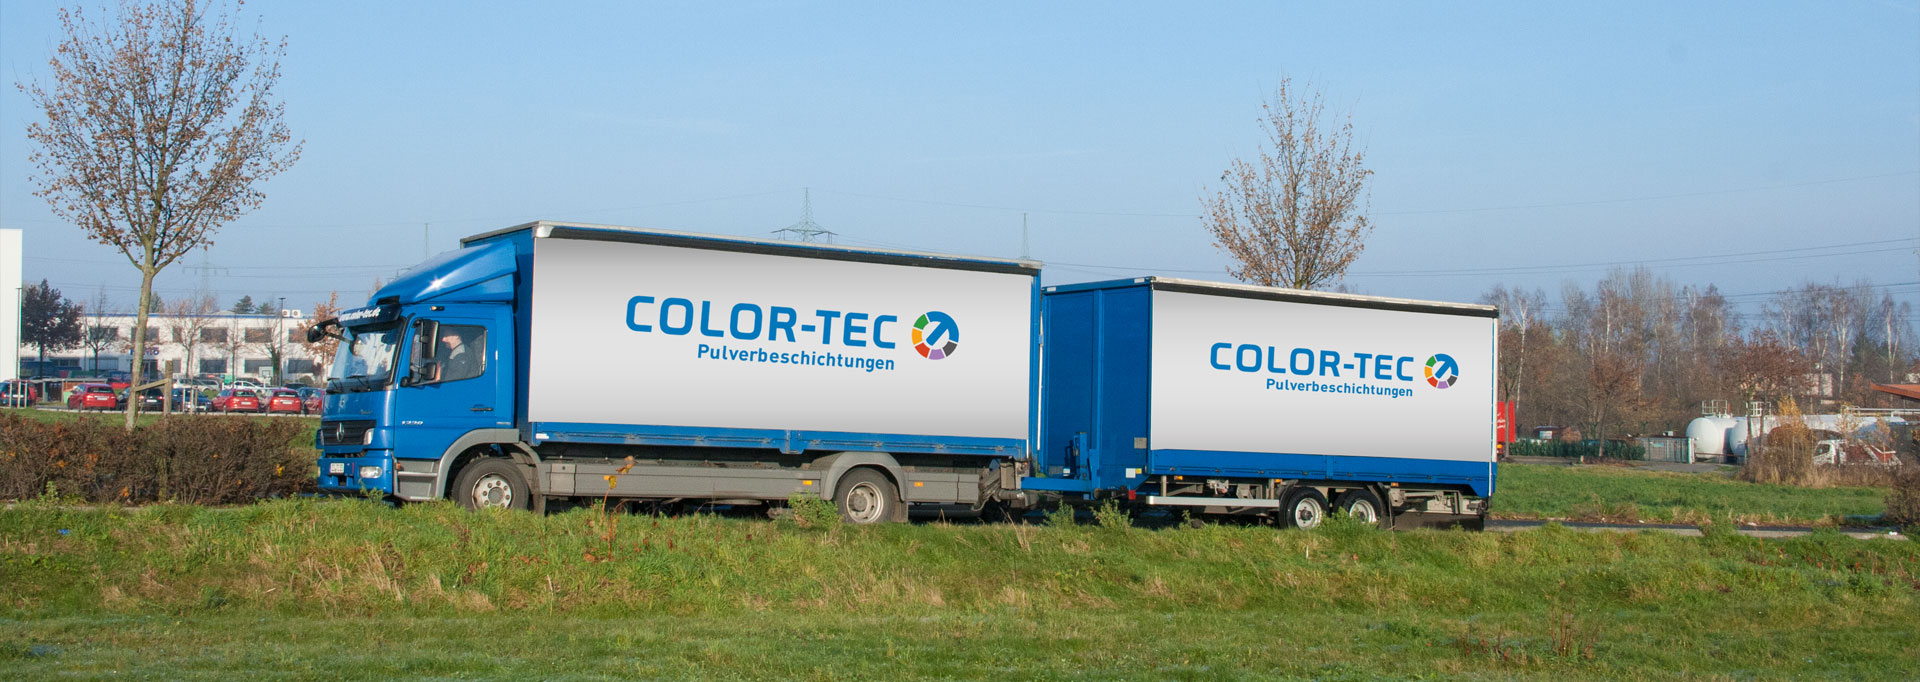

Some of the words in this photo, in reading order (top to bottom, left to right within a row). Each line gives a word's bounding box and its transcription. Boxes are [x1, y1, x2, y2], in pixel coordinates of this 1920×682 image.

[625, 295, 898, 350] COLOR-TEC
[697, 343, 895, 374] Pulverbeschichtungen
[1209, 341, 1415, 382] COLOR-TEC
[1265, 377, 1414, 399] Pulverbeschichtungen
